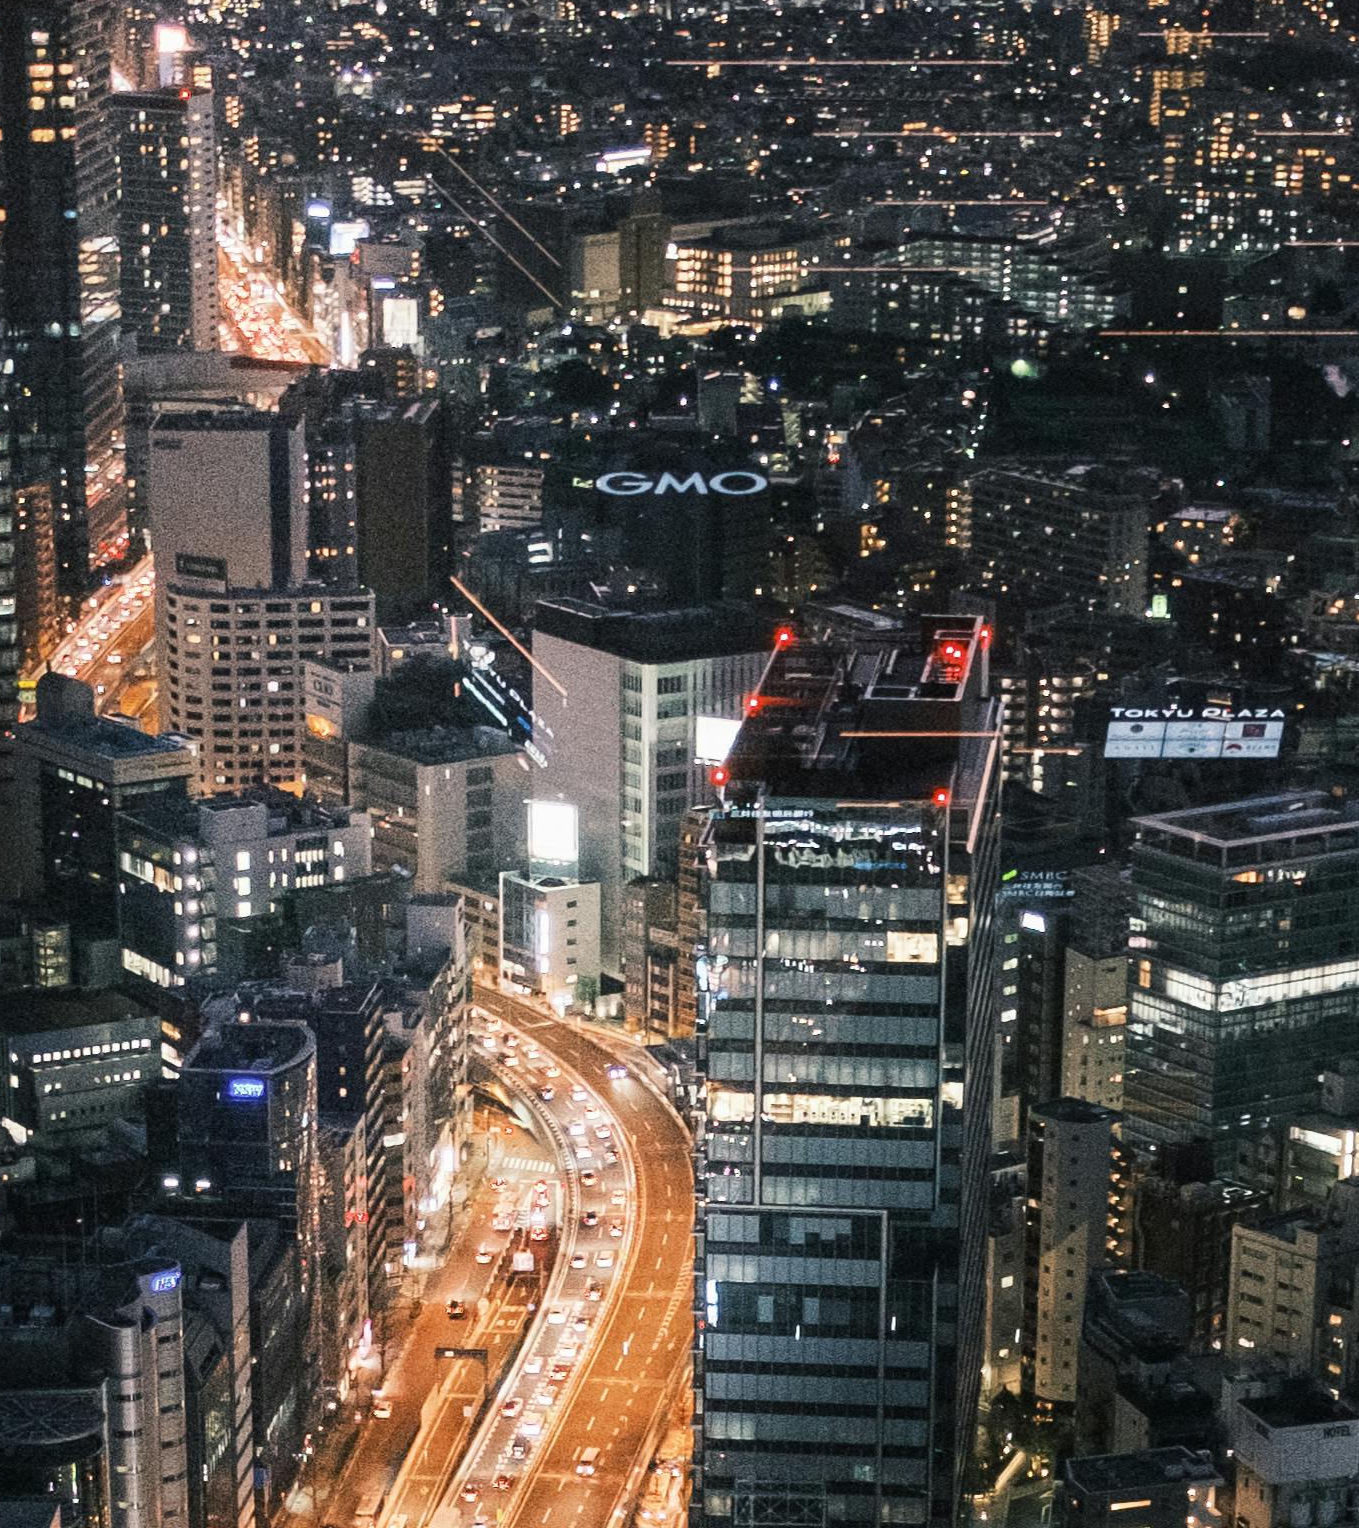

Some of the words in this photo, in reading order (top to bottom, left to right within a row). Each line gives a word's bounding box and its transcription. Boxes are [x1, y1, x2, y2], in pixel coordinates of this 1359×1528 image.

[596, 472, 768, 496] GMO
[1110, 707, 1194, 718] TOKYU
[1202, 707, 1285, 718] PLAZA
